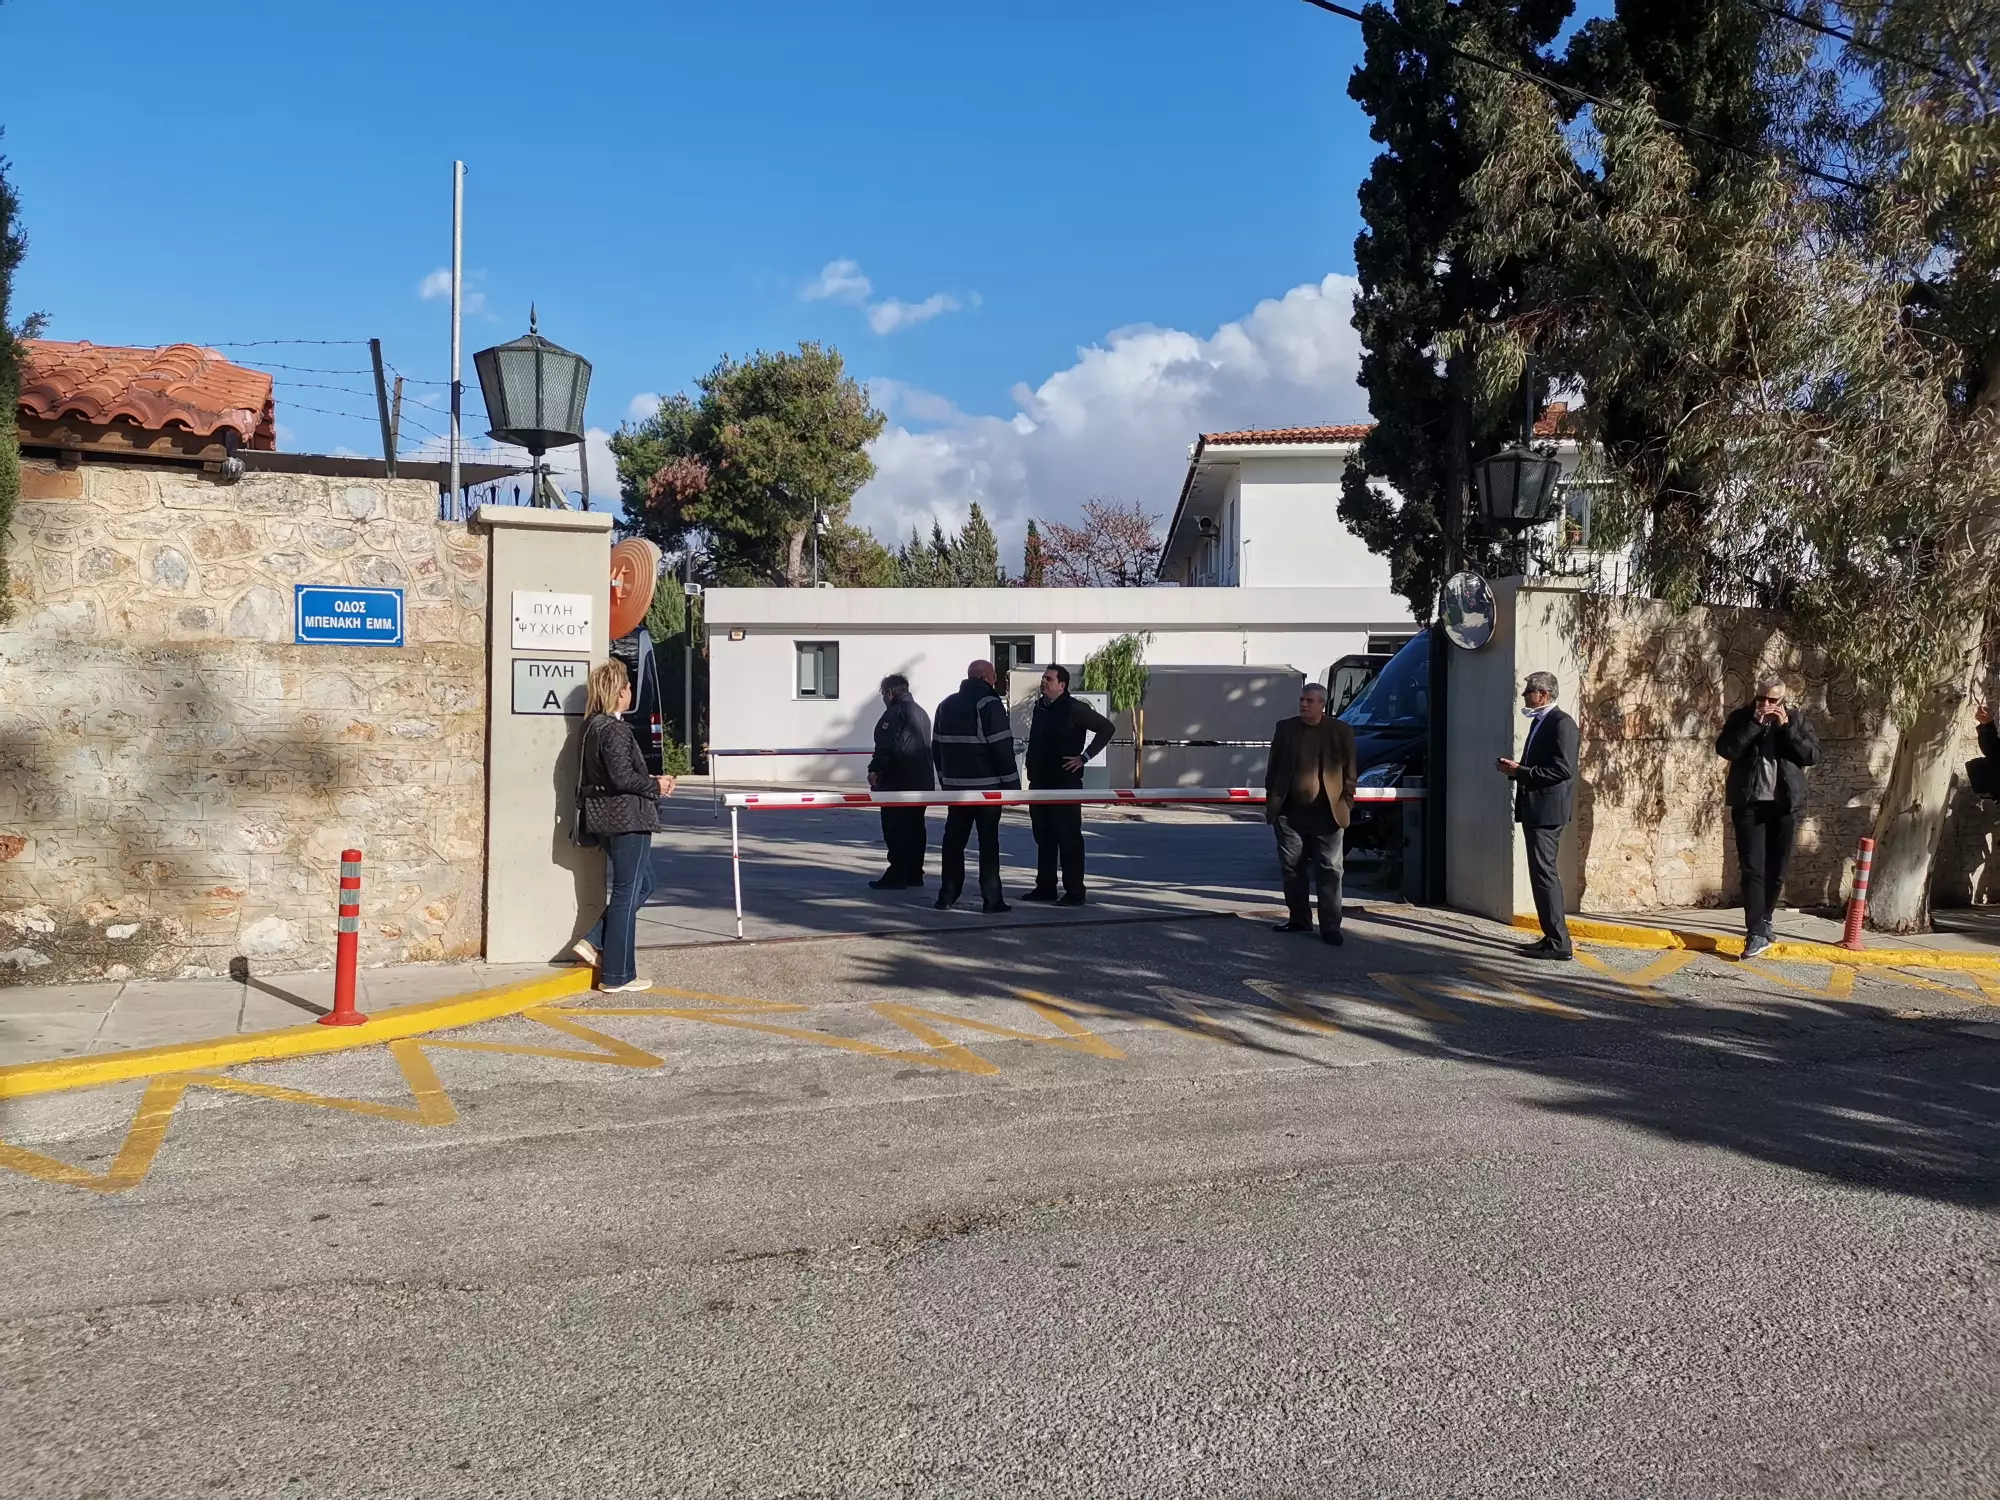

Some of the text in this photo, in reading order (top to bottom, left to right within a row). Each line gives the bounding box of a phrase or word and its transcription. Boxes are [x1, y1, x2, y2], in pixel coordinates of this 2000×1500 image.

[334, 600, 367, 613] ΟΔΟΣ
[533, 603, 573, 616] ΠΥΛΗ
[305, 615, 396, 630] ΜΠΕΝΑΚΗ ΕΜΜ.
[518, 622, 585, 635] ΨΥΧΙΚΟΥ
[529, 664, 574, 678] ΠΥΛΗ
[542, 689, 562, 709] Α
